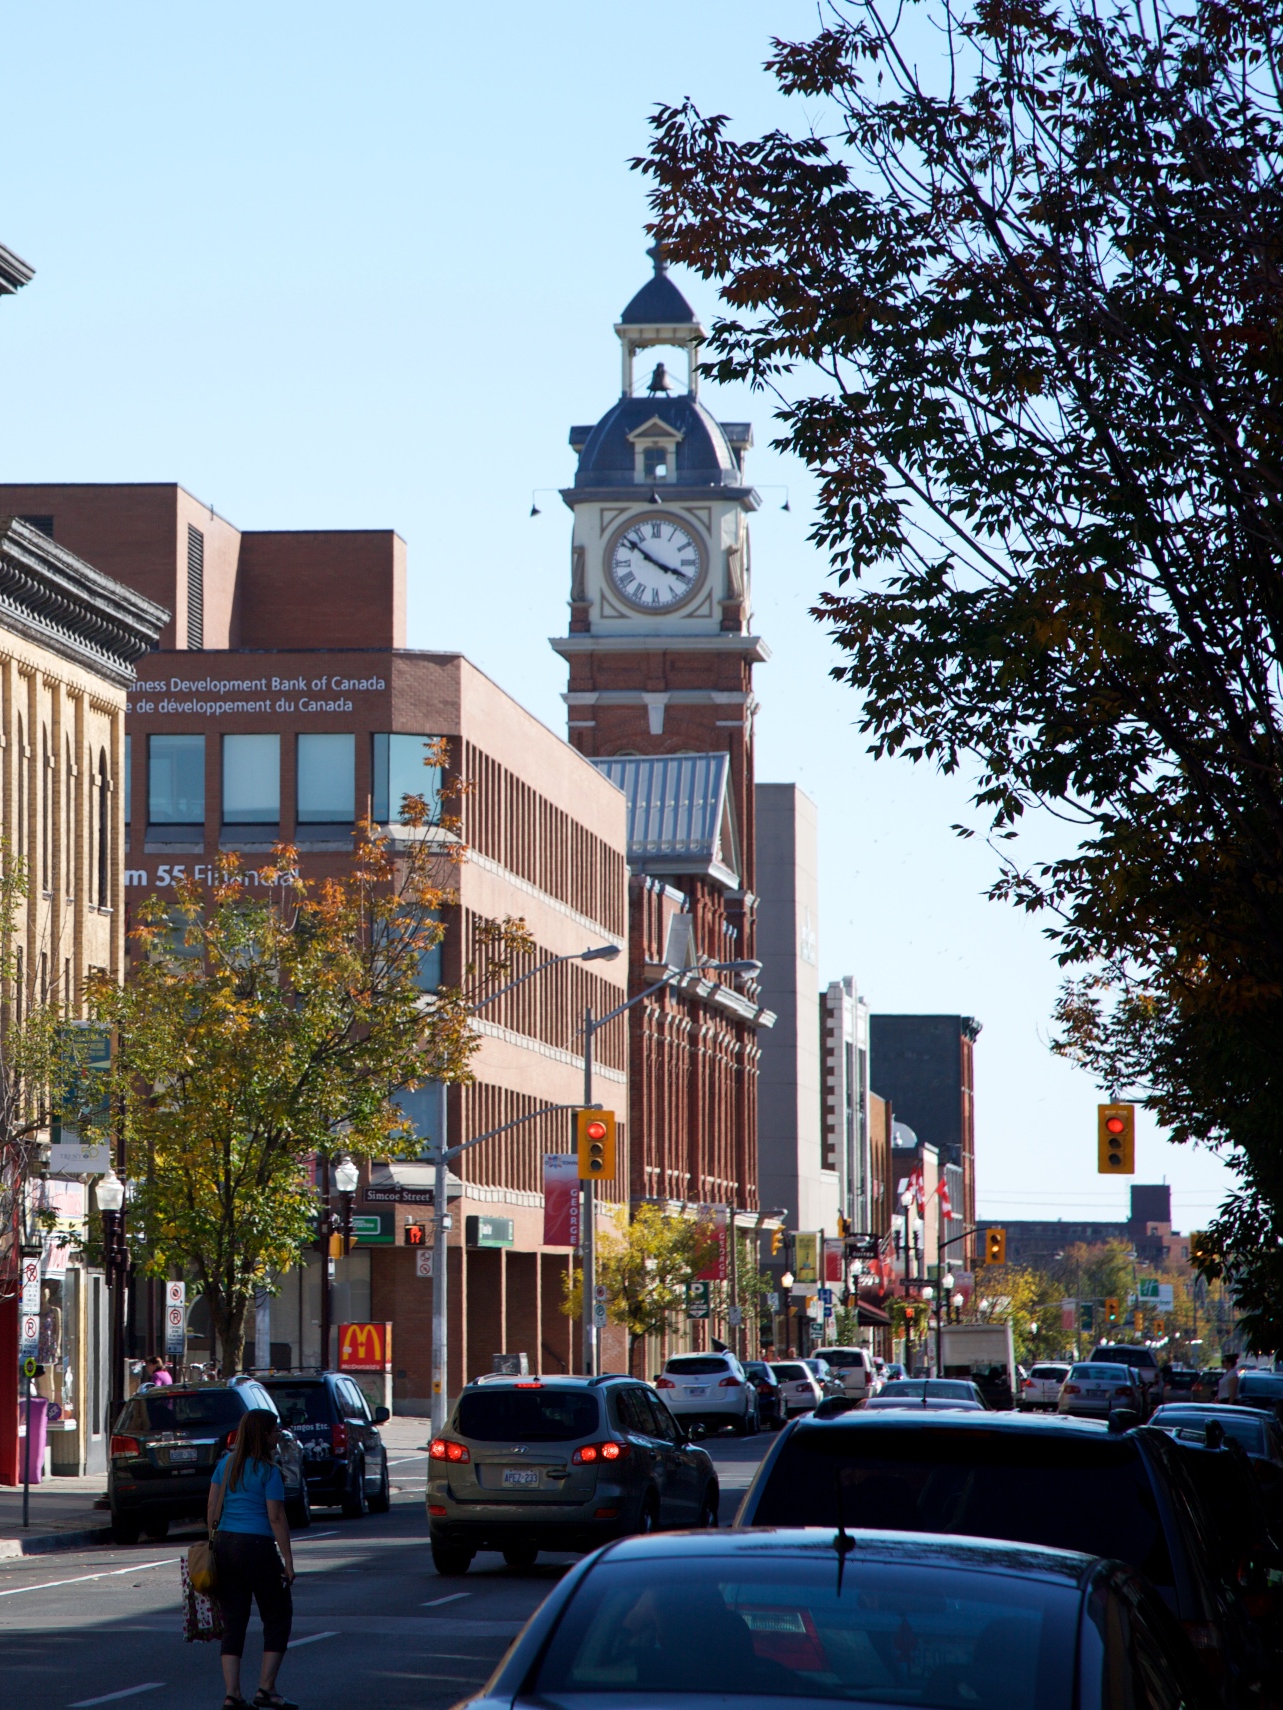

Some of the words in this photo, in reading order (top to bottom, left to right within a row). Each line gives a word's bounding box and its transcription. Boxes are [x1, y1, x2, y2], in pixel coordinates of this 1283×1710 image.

[125, 680, 167, 693] iness
[170, 676, 267, 695] Development
[271, 675, 307, 691] Bank
[311, 675, 327, 690] of
[331, 675, 385, 690] Canada
[136, 698, 155, 713] de
[158, 697, 272, 716] développement
[275, 696, 295, 712] du
[298, 696, 353, 712] Canada
[155, 864, 186, 887] 55
[367, 1190, 400, 1201] Simcoe
[402, 1191, 430, 1202] Street
[569, 1188, 578, 1245] GEORGE
[504, 1473, 522, 1483] APEZ
[524, 1473, 538, 1483] 233
